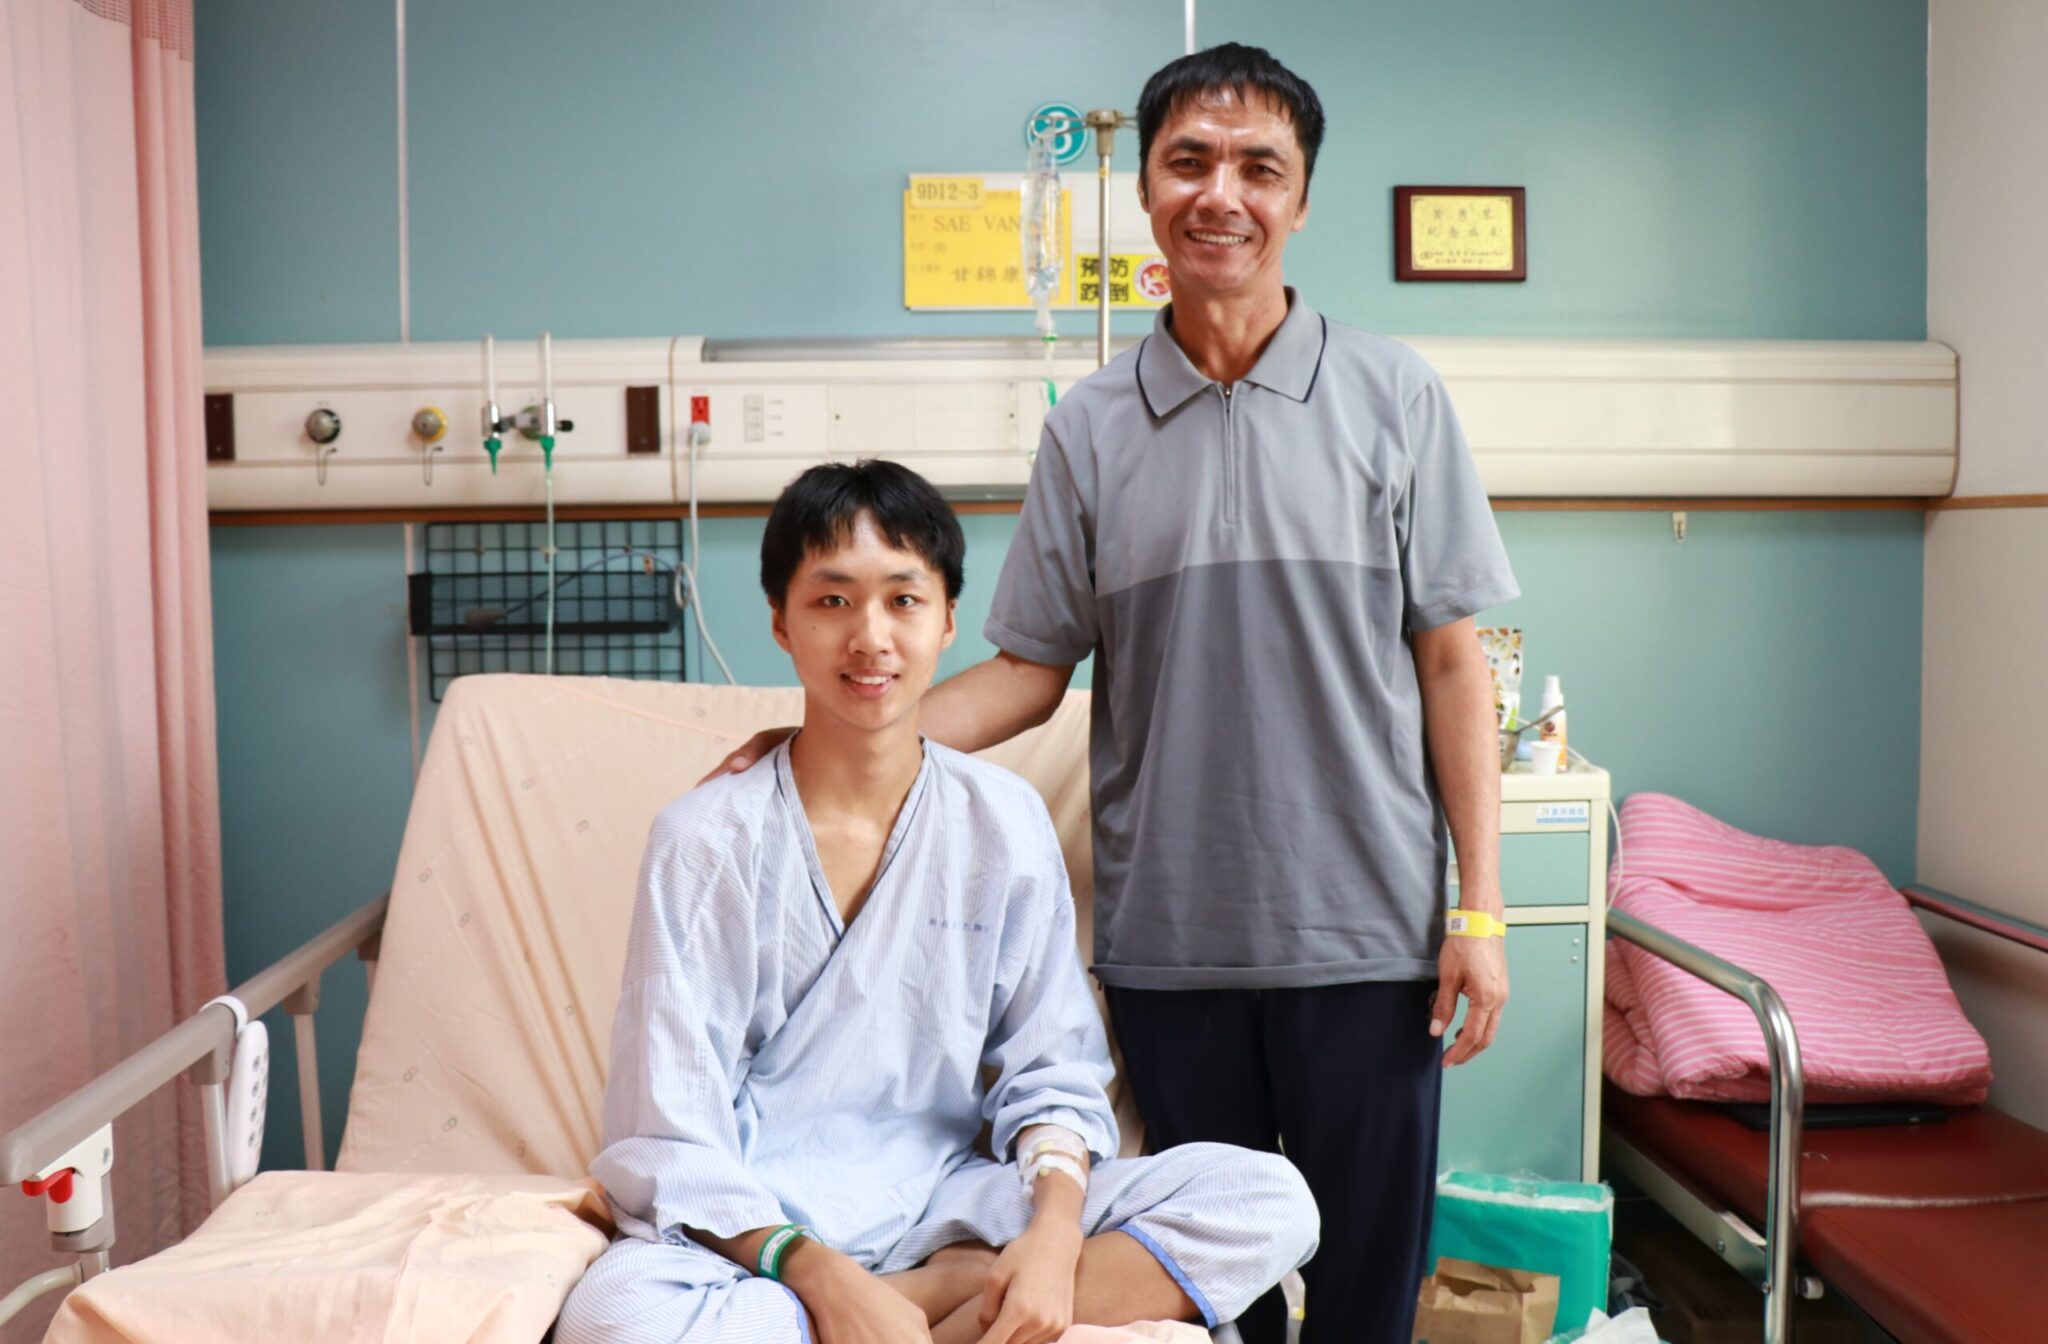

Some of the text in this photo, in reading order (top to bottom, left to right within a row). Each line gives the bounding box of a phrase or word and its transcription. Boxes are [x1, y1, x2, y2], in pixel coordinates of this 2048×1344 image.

[1045, 111, 1072, 154] 3
[934, 214, 971, 232] SAE
[1080, 257, 1129, 278] 預防
[1080, 283, 1129, 303] 跌倒
